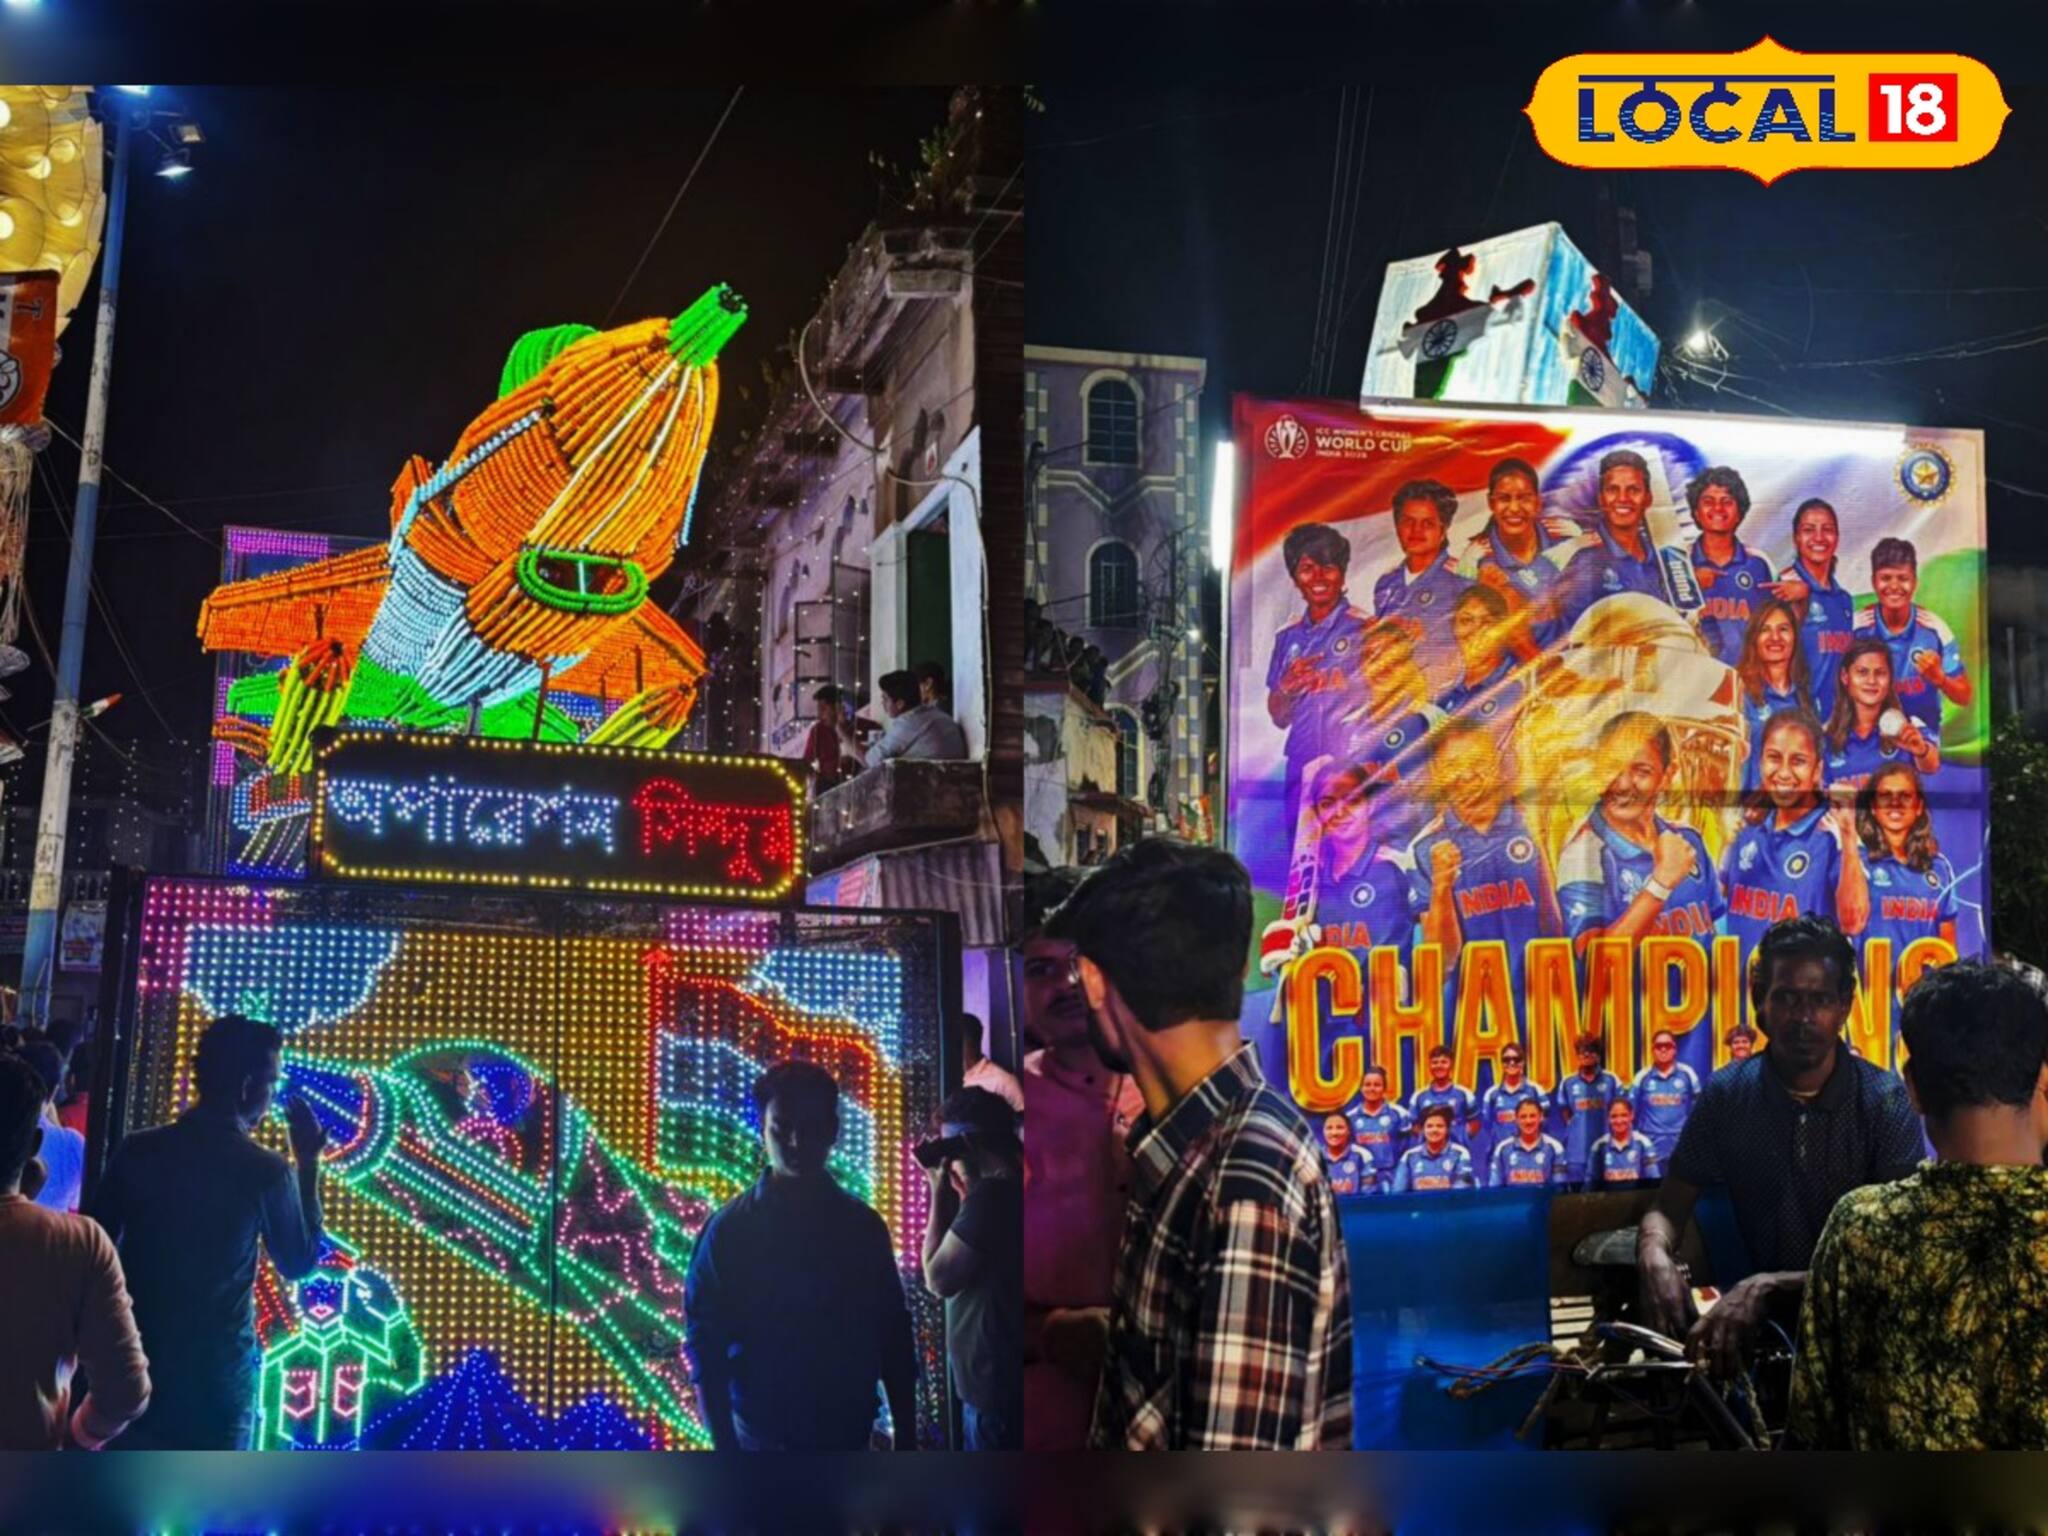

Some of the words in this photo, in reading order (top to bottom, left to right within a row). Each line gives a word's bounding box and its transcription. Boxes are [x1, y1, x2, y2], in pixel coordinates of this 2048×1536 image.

[1315, 436, 1377, 452] WORLD
[1379, 440, 1413, 453] CUP
[325, 776, 621, 853] অপারেশন
[1457, 878, 1535, 919] NDIA
[1881, 895, 1940, 922] INDIA
